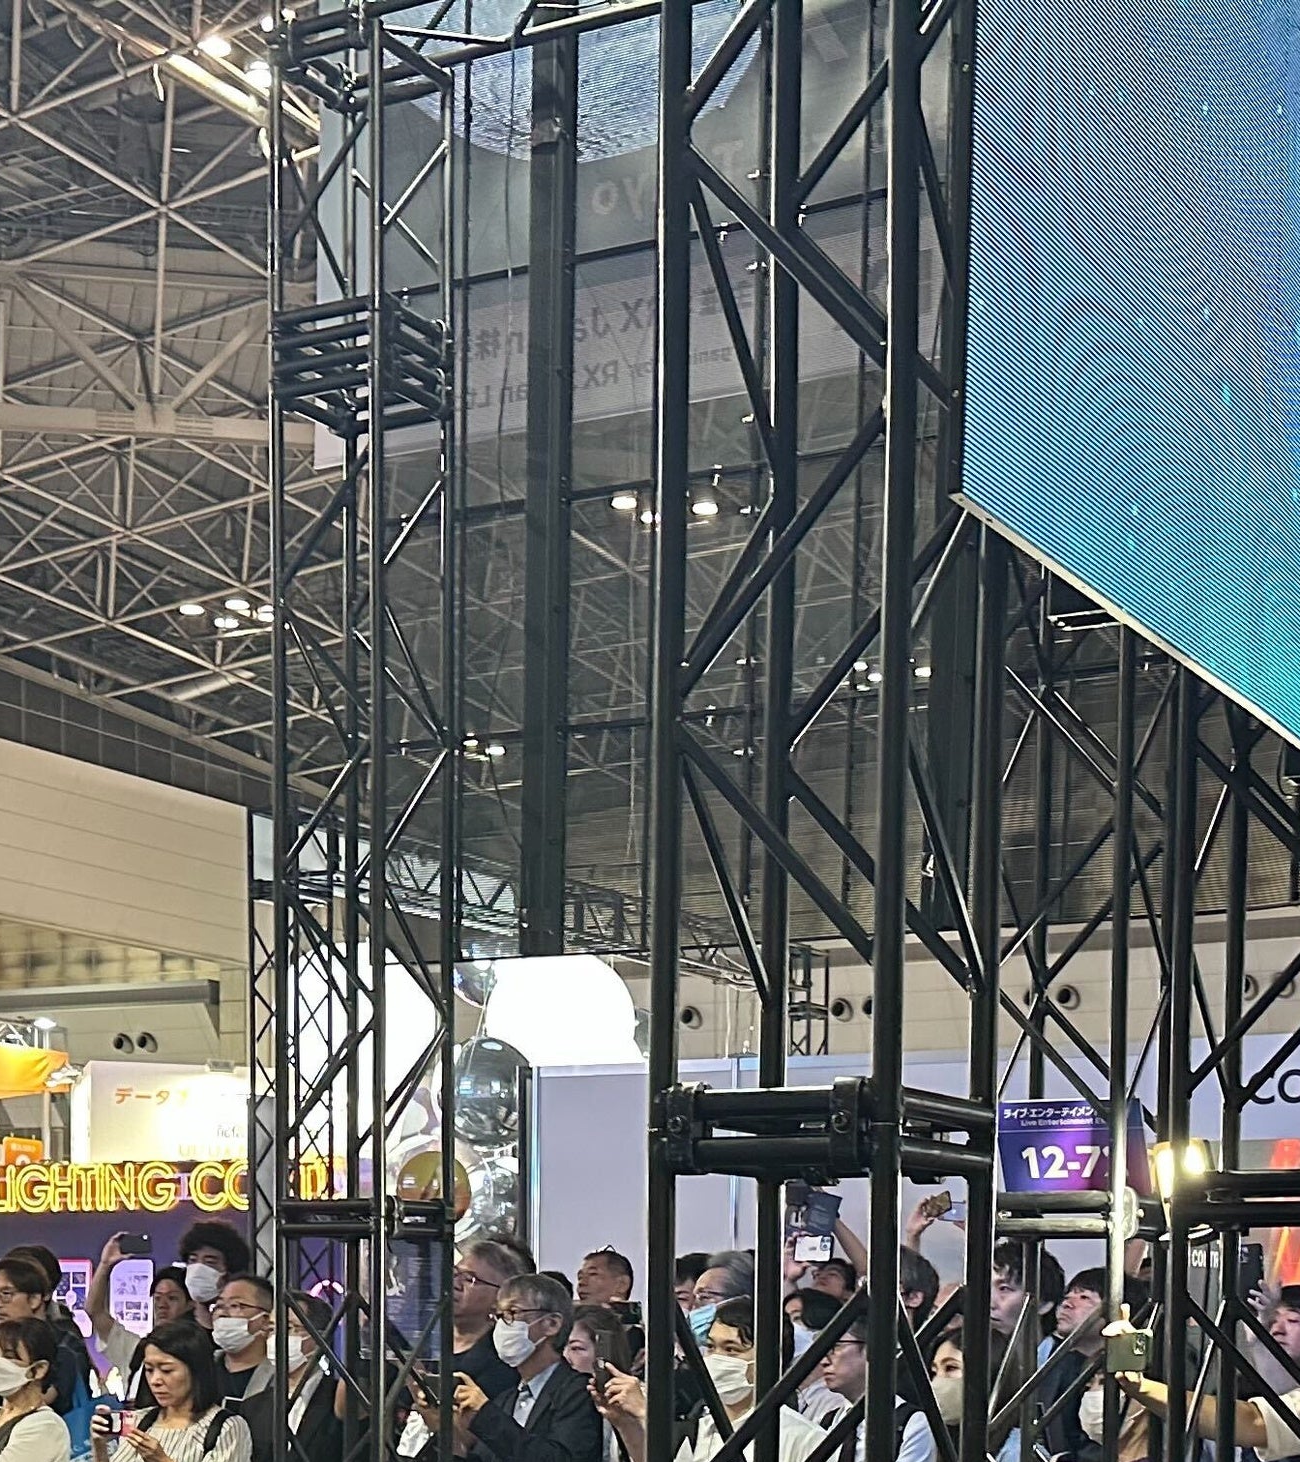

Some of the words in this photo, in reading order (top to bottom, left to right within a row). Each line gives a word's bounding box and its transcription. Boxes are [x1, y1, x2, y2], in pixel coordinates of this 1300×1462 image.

[1003, 1106, 1098, 1119] ライブ・エンターテイメン
